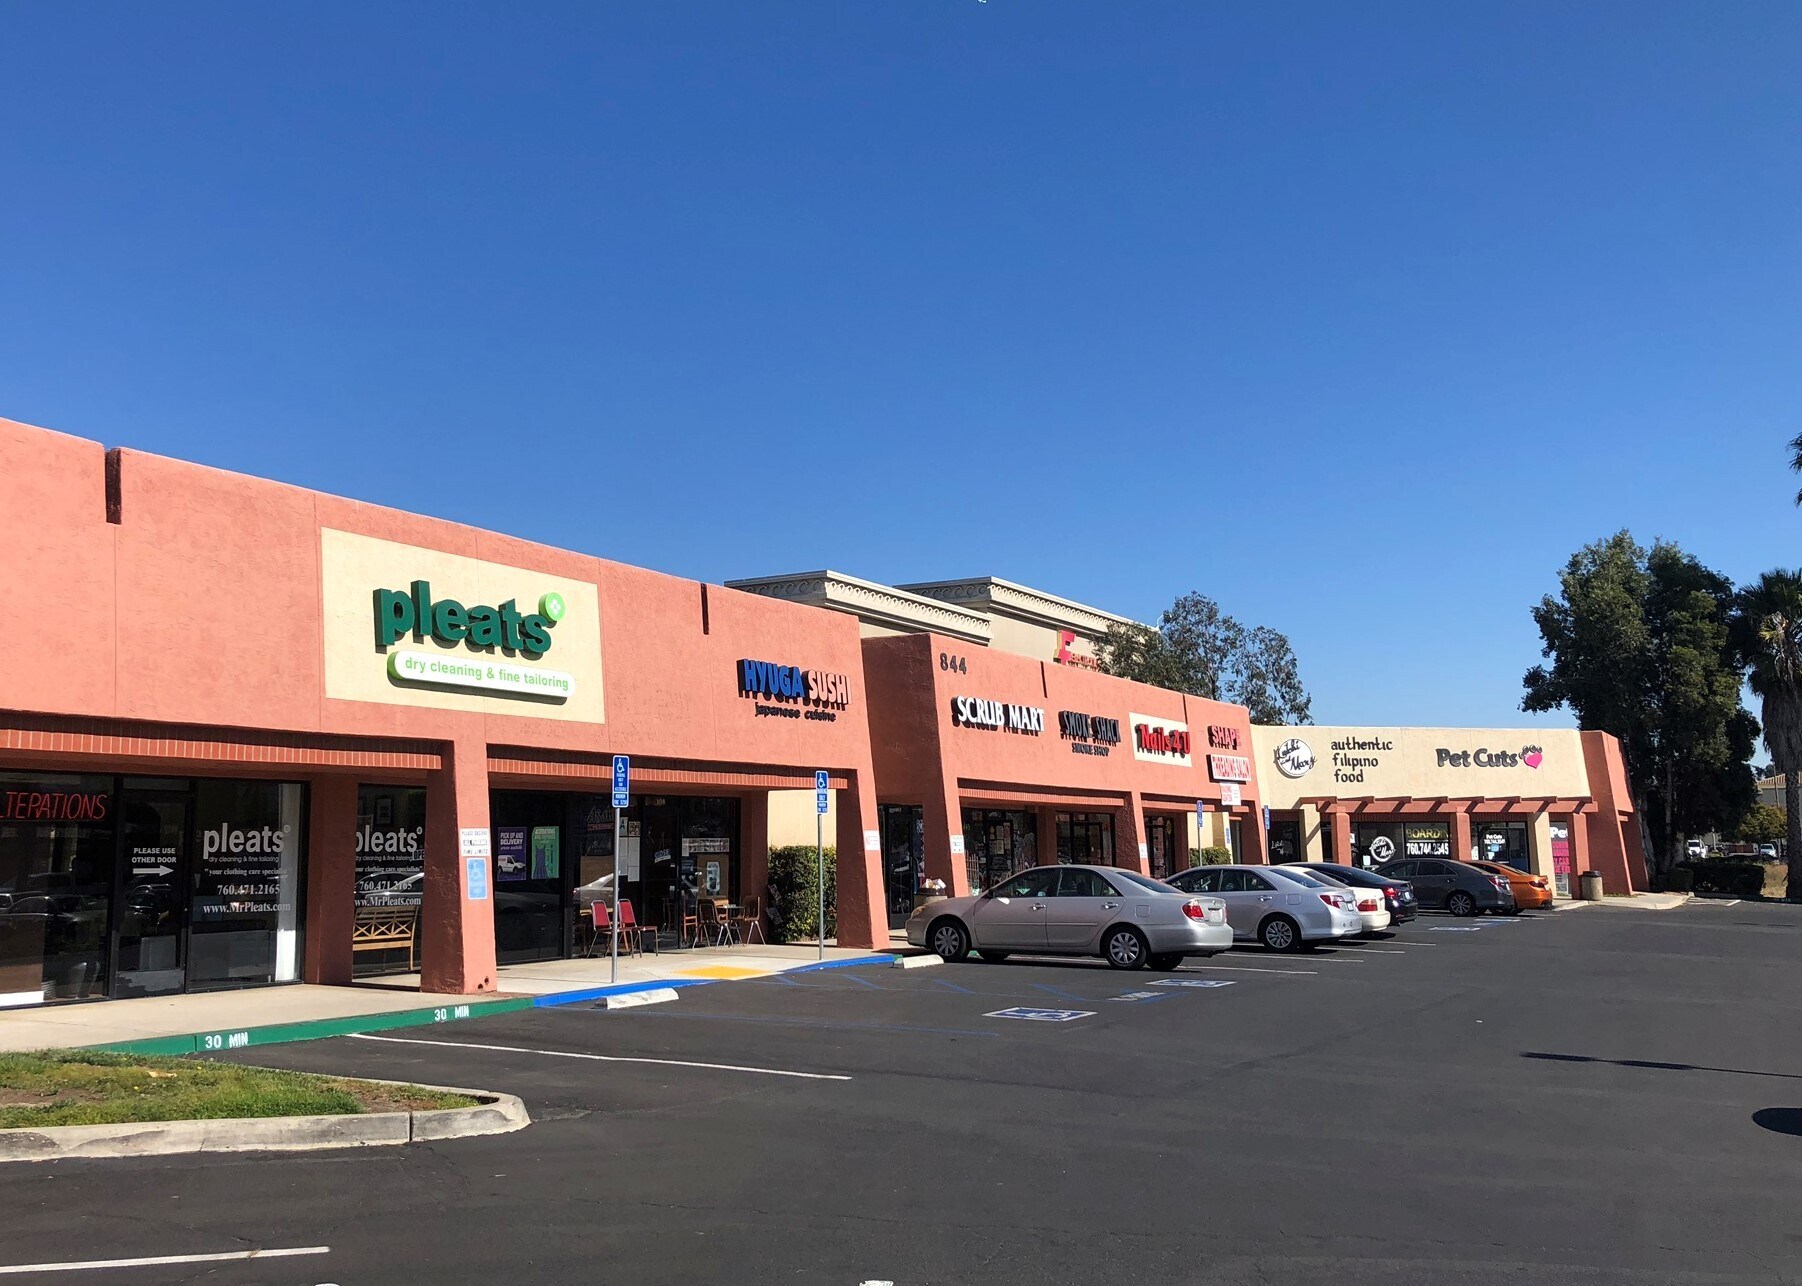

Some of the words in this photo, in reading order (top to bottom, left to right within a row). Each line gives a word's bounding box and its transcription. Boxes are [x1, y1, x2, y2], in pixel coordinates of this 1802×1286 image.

[374, 580, 552, 654] pleats
[940, 653, 967, 675] 844
[405, 657, 426, 673] dry
[430, 661, 482, 680] cleaning
[486, 667, 495, 679] &
[499, 670, 520, 683] fine
[524, 673, 569, 691] tailoring
[743, 659, 805, 698] HYUGA
[807, 669, 852, 705] SUSHI
[755, 702, 801, 718] japanese
[956, 696, 1005, 726] SCRUB
[1008, 704, 1045, 732] MART
[1062, 711, 1091, 738] SMOKE
[1140, 723, 1171, 750] Nails
[1331, 736, 1393, 751] authentic
[1332, 753, 1378, 771] filipino
[1435, 748, 1471, 767] Pet
[1473, 748, 1518, 767] Cuts
[1334, 769, 1364, 783] food
[0, 792, 107, 820] TERATIONS
[203, 823, 285, 859] pleats
[1406, 828, 1450, 839] BOARDIN
[223, 868, 247, 876] clothing
[217, 884, 280, 895] 760.471.2165
[203, 902, 291, 913] www.MrPleats.com
[354, 896, 421, 907] ww.MrPleats.com
[434, 1008, 447, 1021] 30
[454, 1005, 469, 1018] MIN
[205, 1035, 221, 1049] 30
[229, 1032, 248, 1048] MIN
